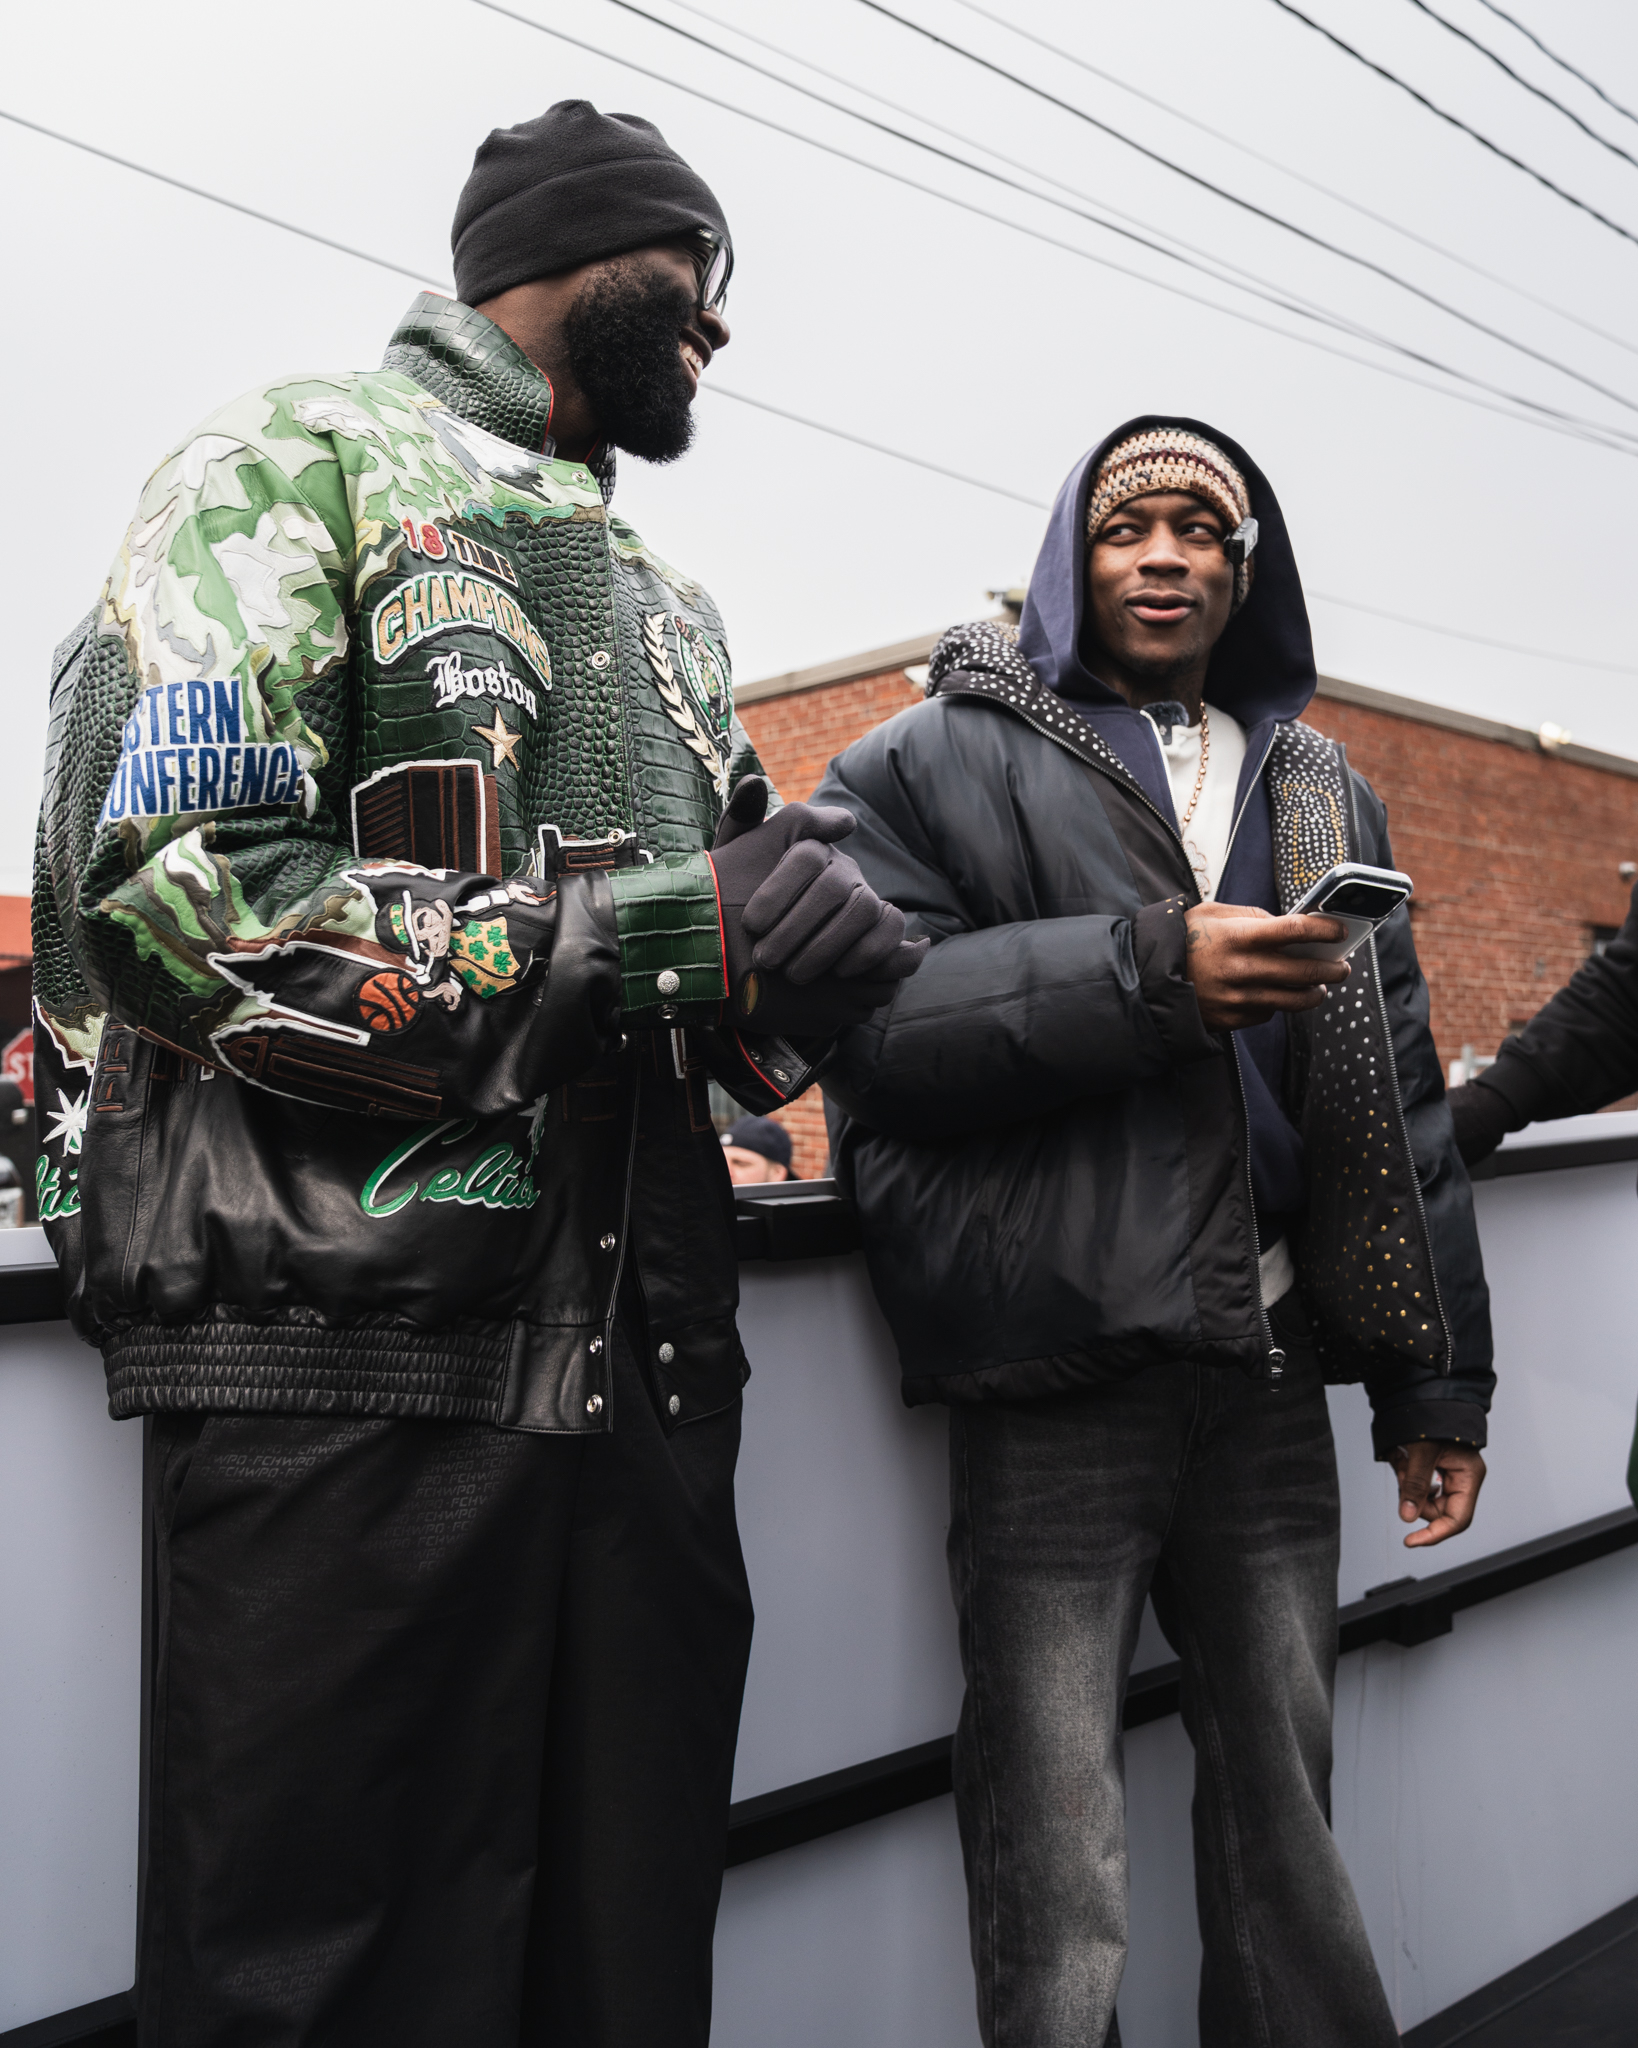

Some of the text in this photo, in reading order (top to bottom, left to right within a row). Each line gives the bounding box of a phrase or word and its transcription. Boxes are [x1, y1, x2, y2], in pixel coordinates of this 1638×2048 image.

[400, 515, 518, 588] 18 TIME
[372, 572, 553, 692] CHAMPIONS
[123, 679, 240, 751] STERN
[425, 652, 538, 721] Boston
[98, 744, 302, 828] ONFERENCE
